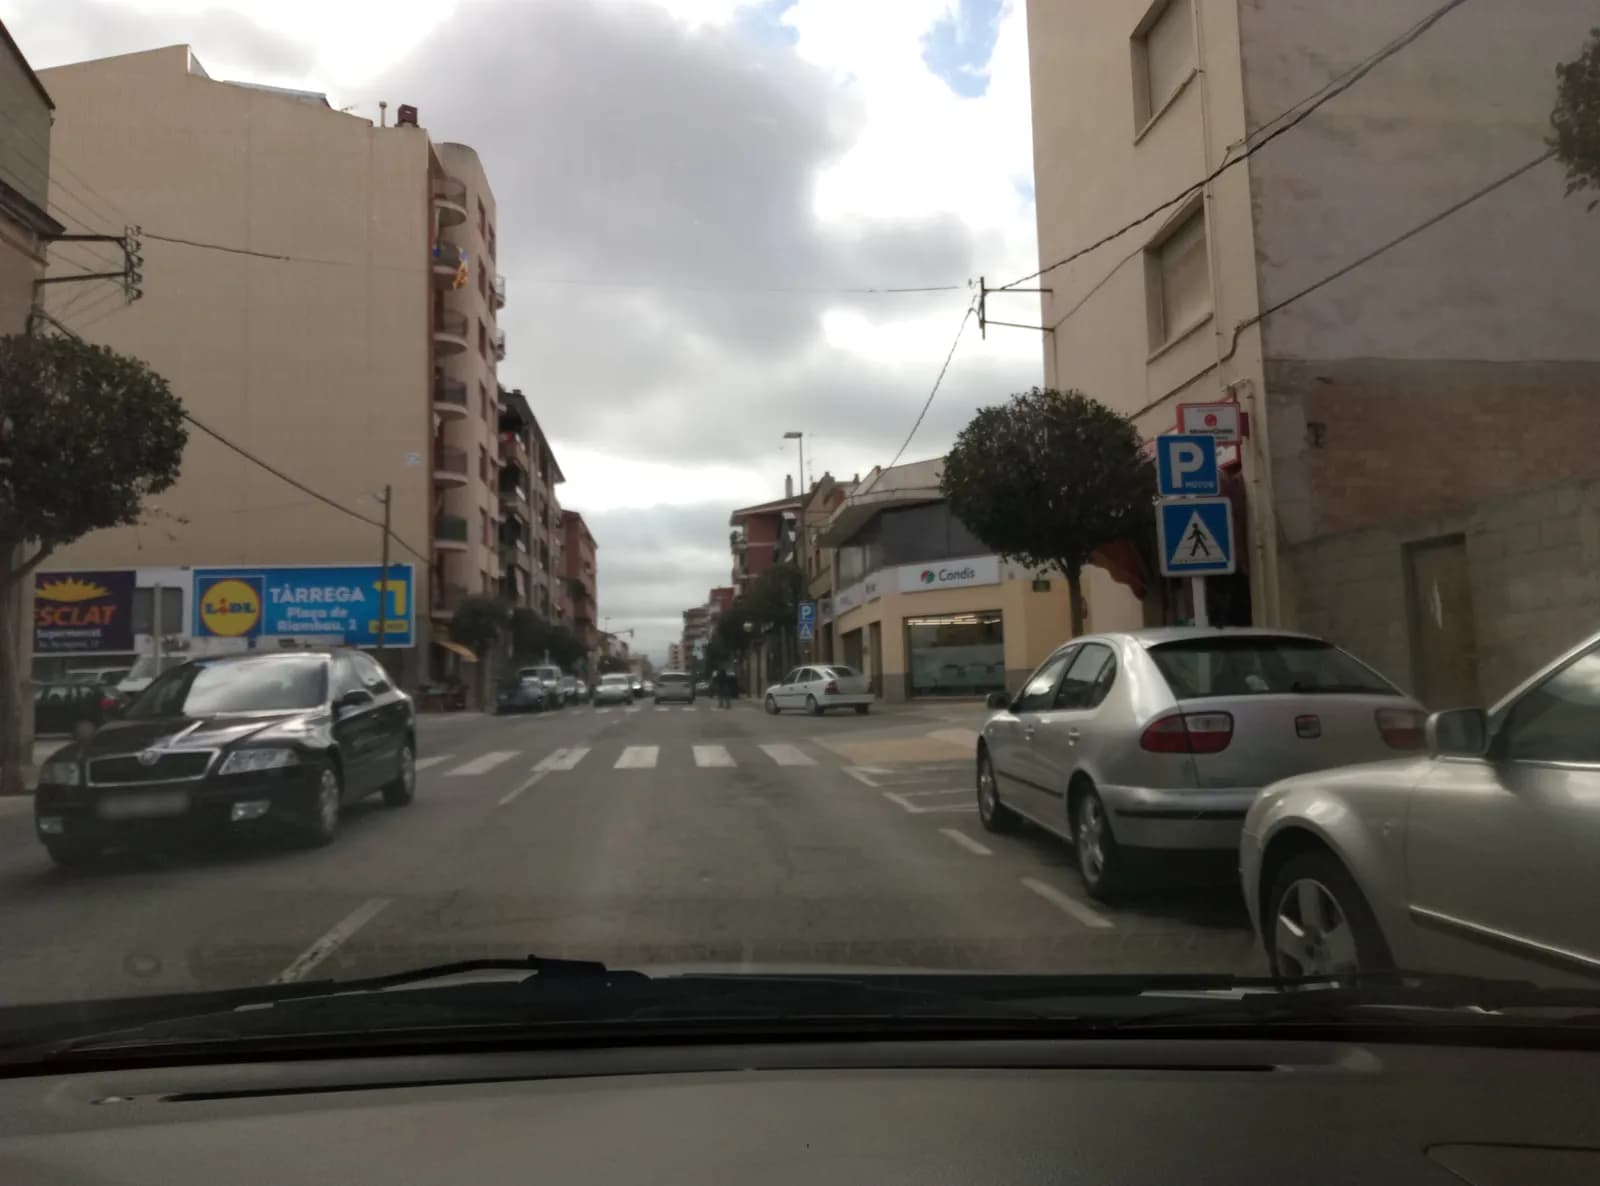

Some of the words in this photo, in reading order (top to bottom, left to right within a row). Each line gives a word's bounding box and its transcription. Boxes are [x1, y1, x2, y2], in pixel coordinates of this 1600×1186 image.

[1170, 442, 1204, 488] P
[938, 567, 976, 582] Condis
[269, 583, 365, 603] TÀRREGA
[330, 606, 349, 618] de
[801, 605, 812, 620] P
[348, 618, 358, 631] 2
